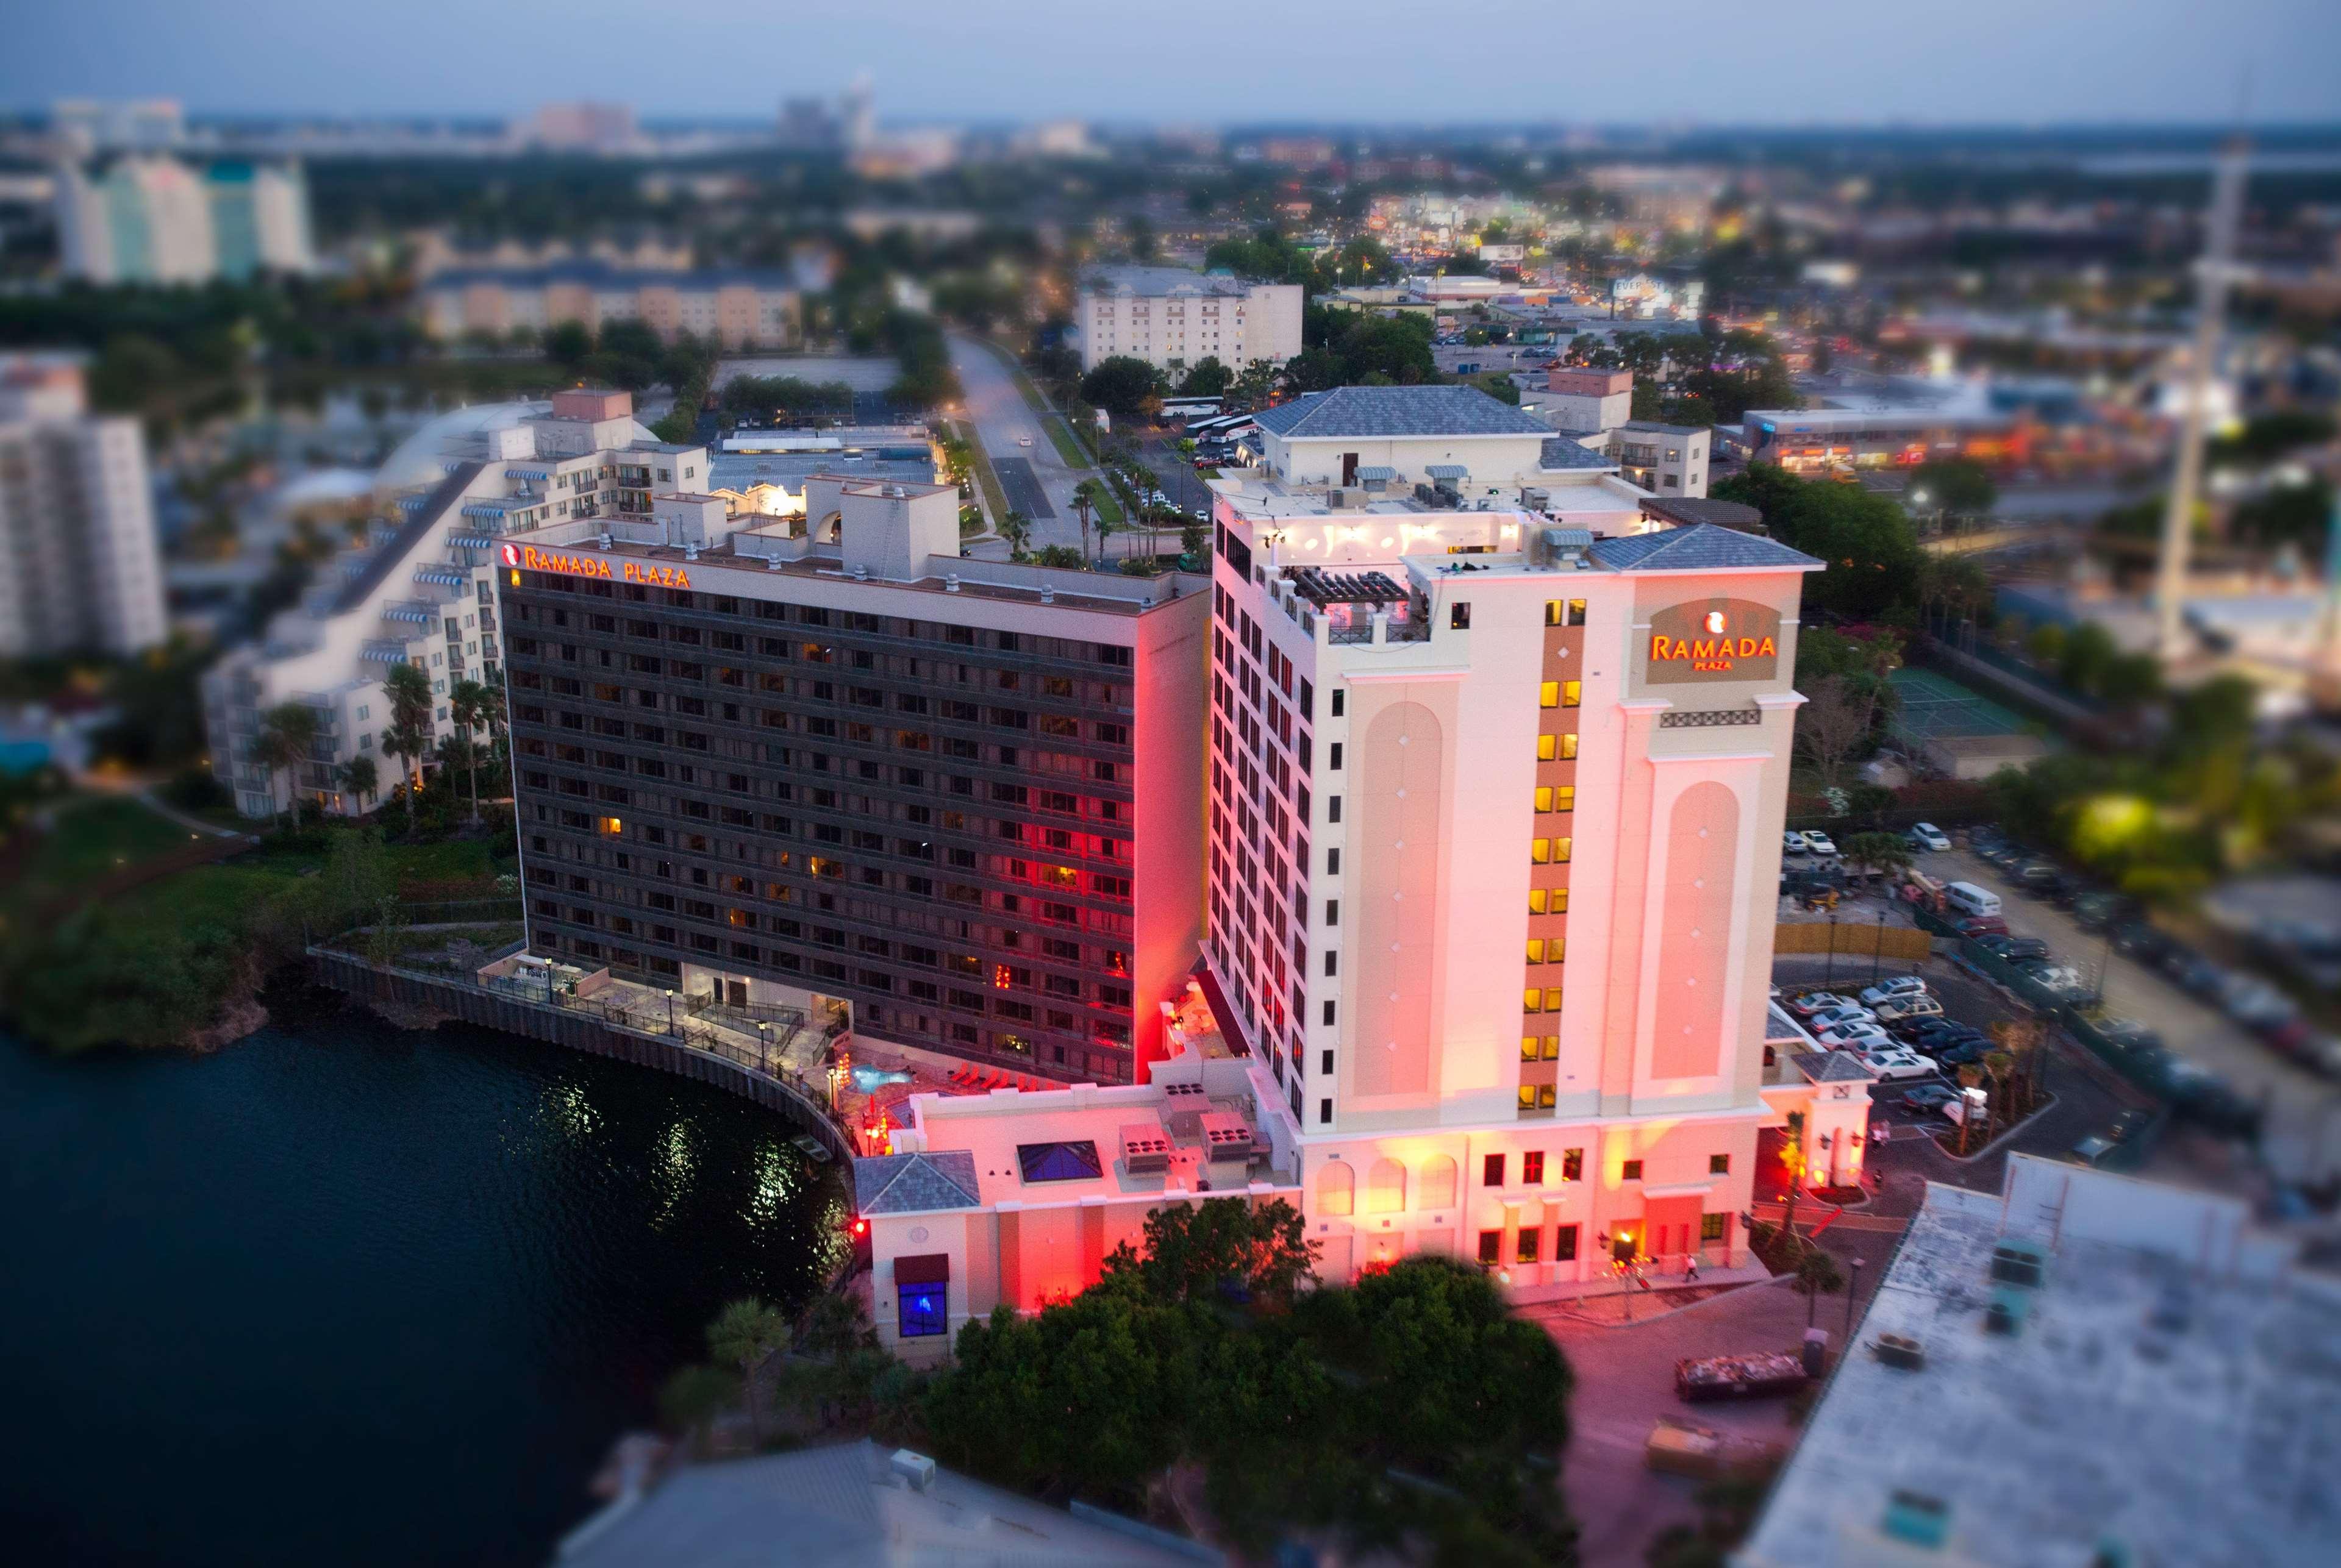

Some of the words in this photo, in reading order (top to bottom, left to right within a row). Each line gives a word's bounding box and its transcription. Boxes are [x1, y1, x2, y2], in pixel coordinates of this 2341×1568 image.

[524, 546, 612, 579] RAMADA
[624, 562, 690, 588] PLAZA
[1651, 635, 1776, 660] RAMADA
[1693, 661, 1732, 671] PLAZA
